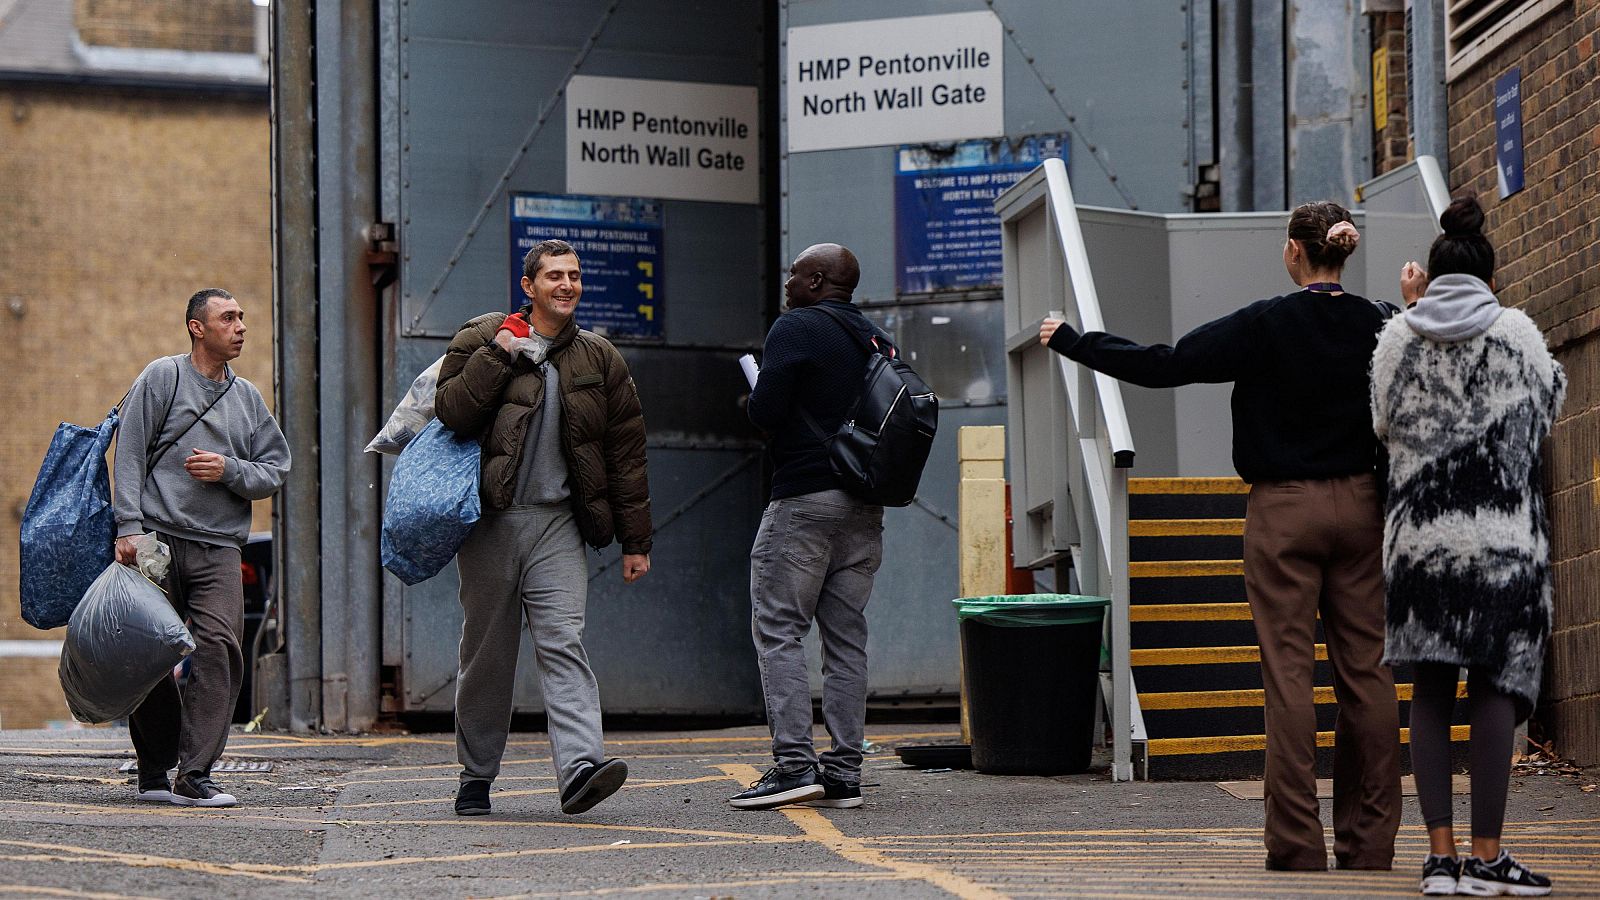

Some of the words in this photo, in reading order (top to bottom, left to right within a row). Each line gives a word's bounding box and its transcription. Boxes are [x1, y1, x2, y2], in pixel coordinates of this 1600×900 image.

[799, 57, 850, 82] HMP
[859, 47, 990, 77] Pentonville
[803, 91, 866, 116] North
[874, 86, 923, 110] Wall
[932, 83, 986, 106] Gate
[577, 108, 625, 131] HMP
[633, 111, 749, 139] Pentonville
[581, 141, 640, 165] North
[646, 145, 690, 168] Wall
[698, 148, 745, 171] Gate
[915, 176, 956, 189] WELCOME
[957, 175, 969, 187] TO
[970, 174, 990, 186] HMP
[942, 189, 972, 202] NORTH
[972, 188, 995, 200] WALL
[526, 225, 568, 238] DIRECTION
[568, 228, 580, 238] TO
[580, 228, 598, 239] HMP
[599, 229, 649, 242] PENTONVILLE
[587, 241, 609, 252] FROM
[609, 243, 636, 254] NORTH
[635, 244, 657, 255] WALL
